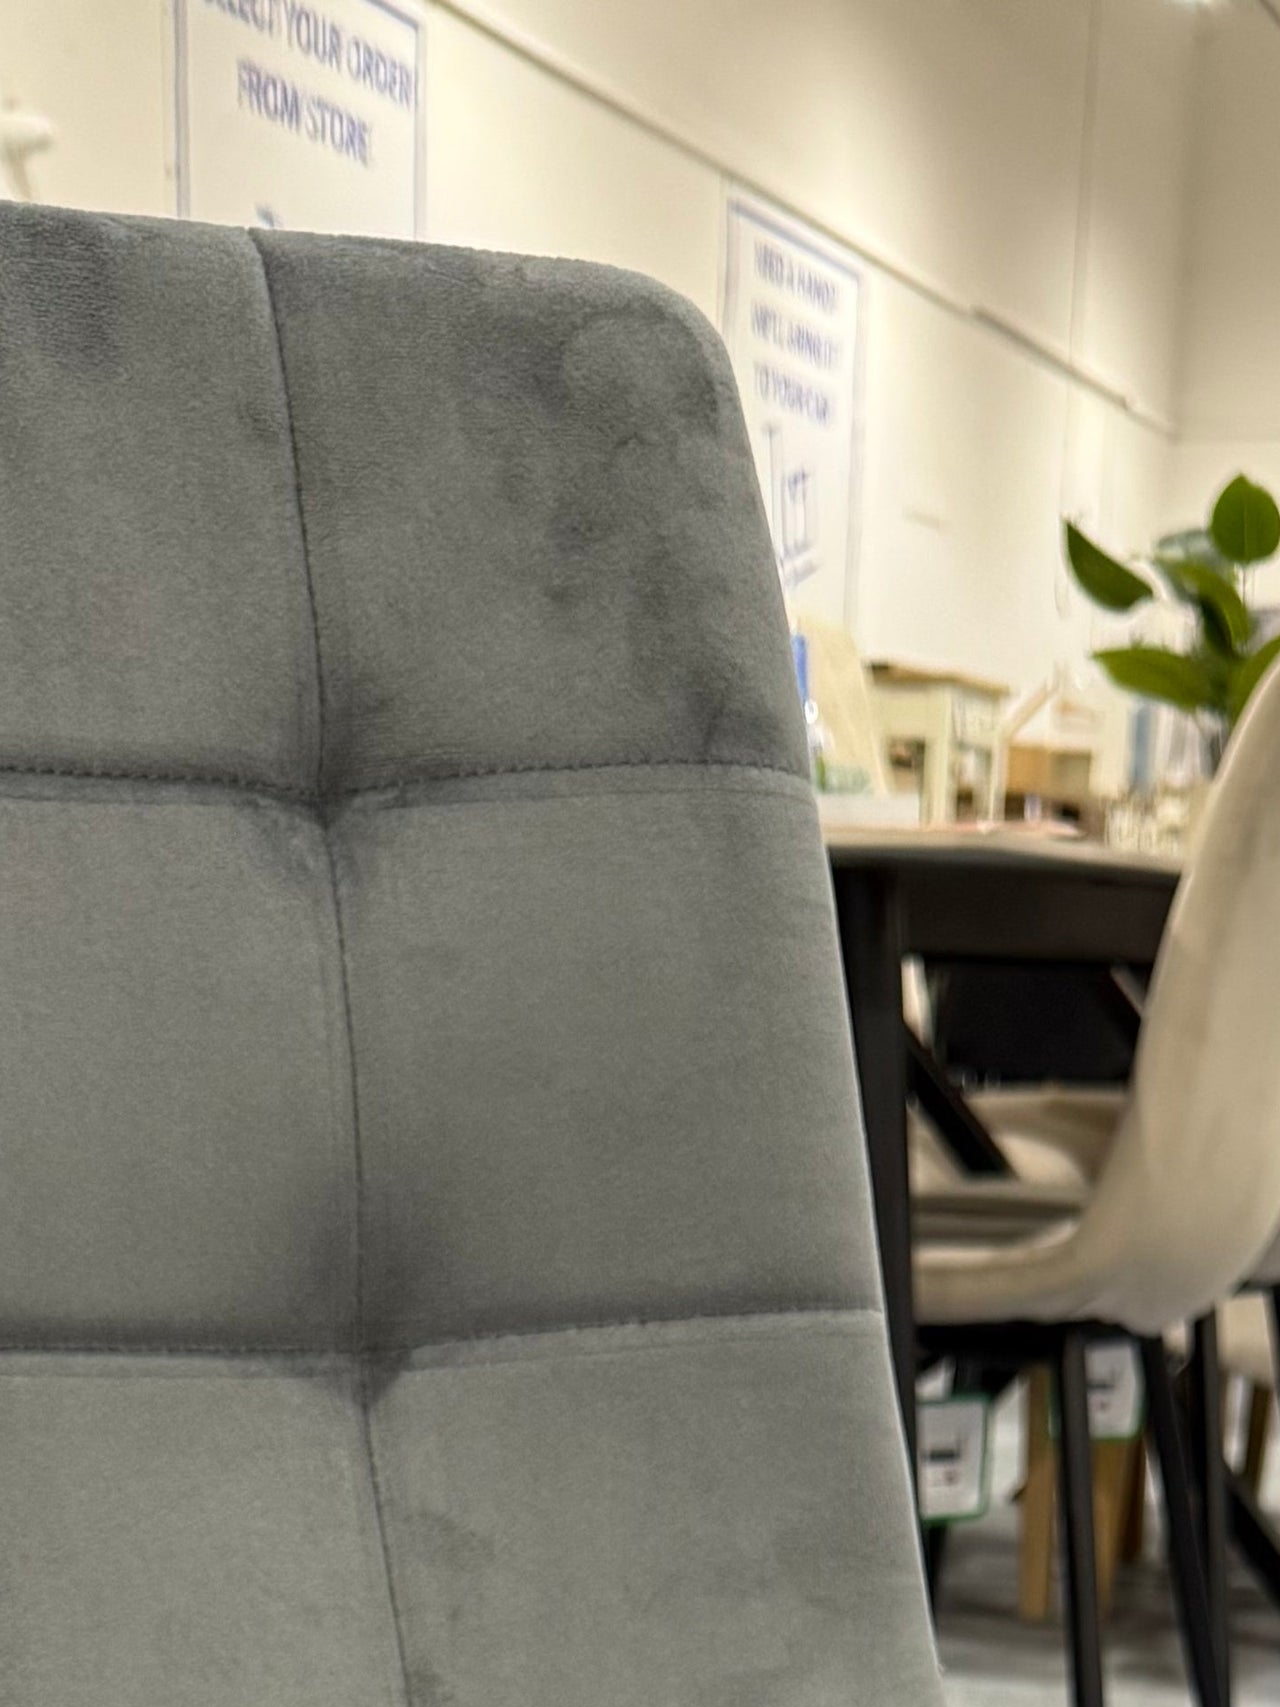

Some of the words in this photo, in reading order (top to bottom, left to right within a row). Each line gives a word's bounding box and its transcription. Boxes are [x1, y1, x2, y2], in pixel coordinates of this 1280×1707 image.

[284, 0, 343, 74] YOUR
[346, 34, 412, 110] ORDER
[237, 57, 300, 134] FROM
[305, 95, 372, 168] STORE
